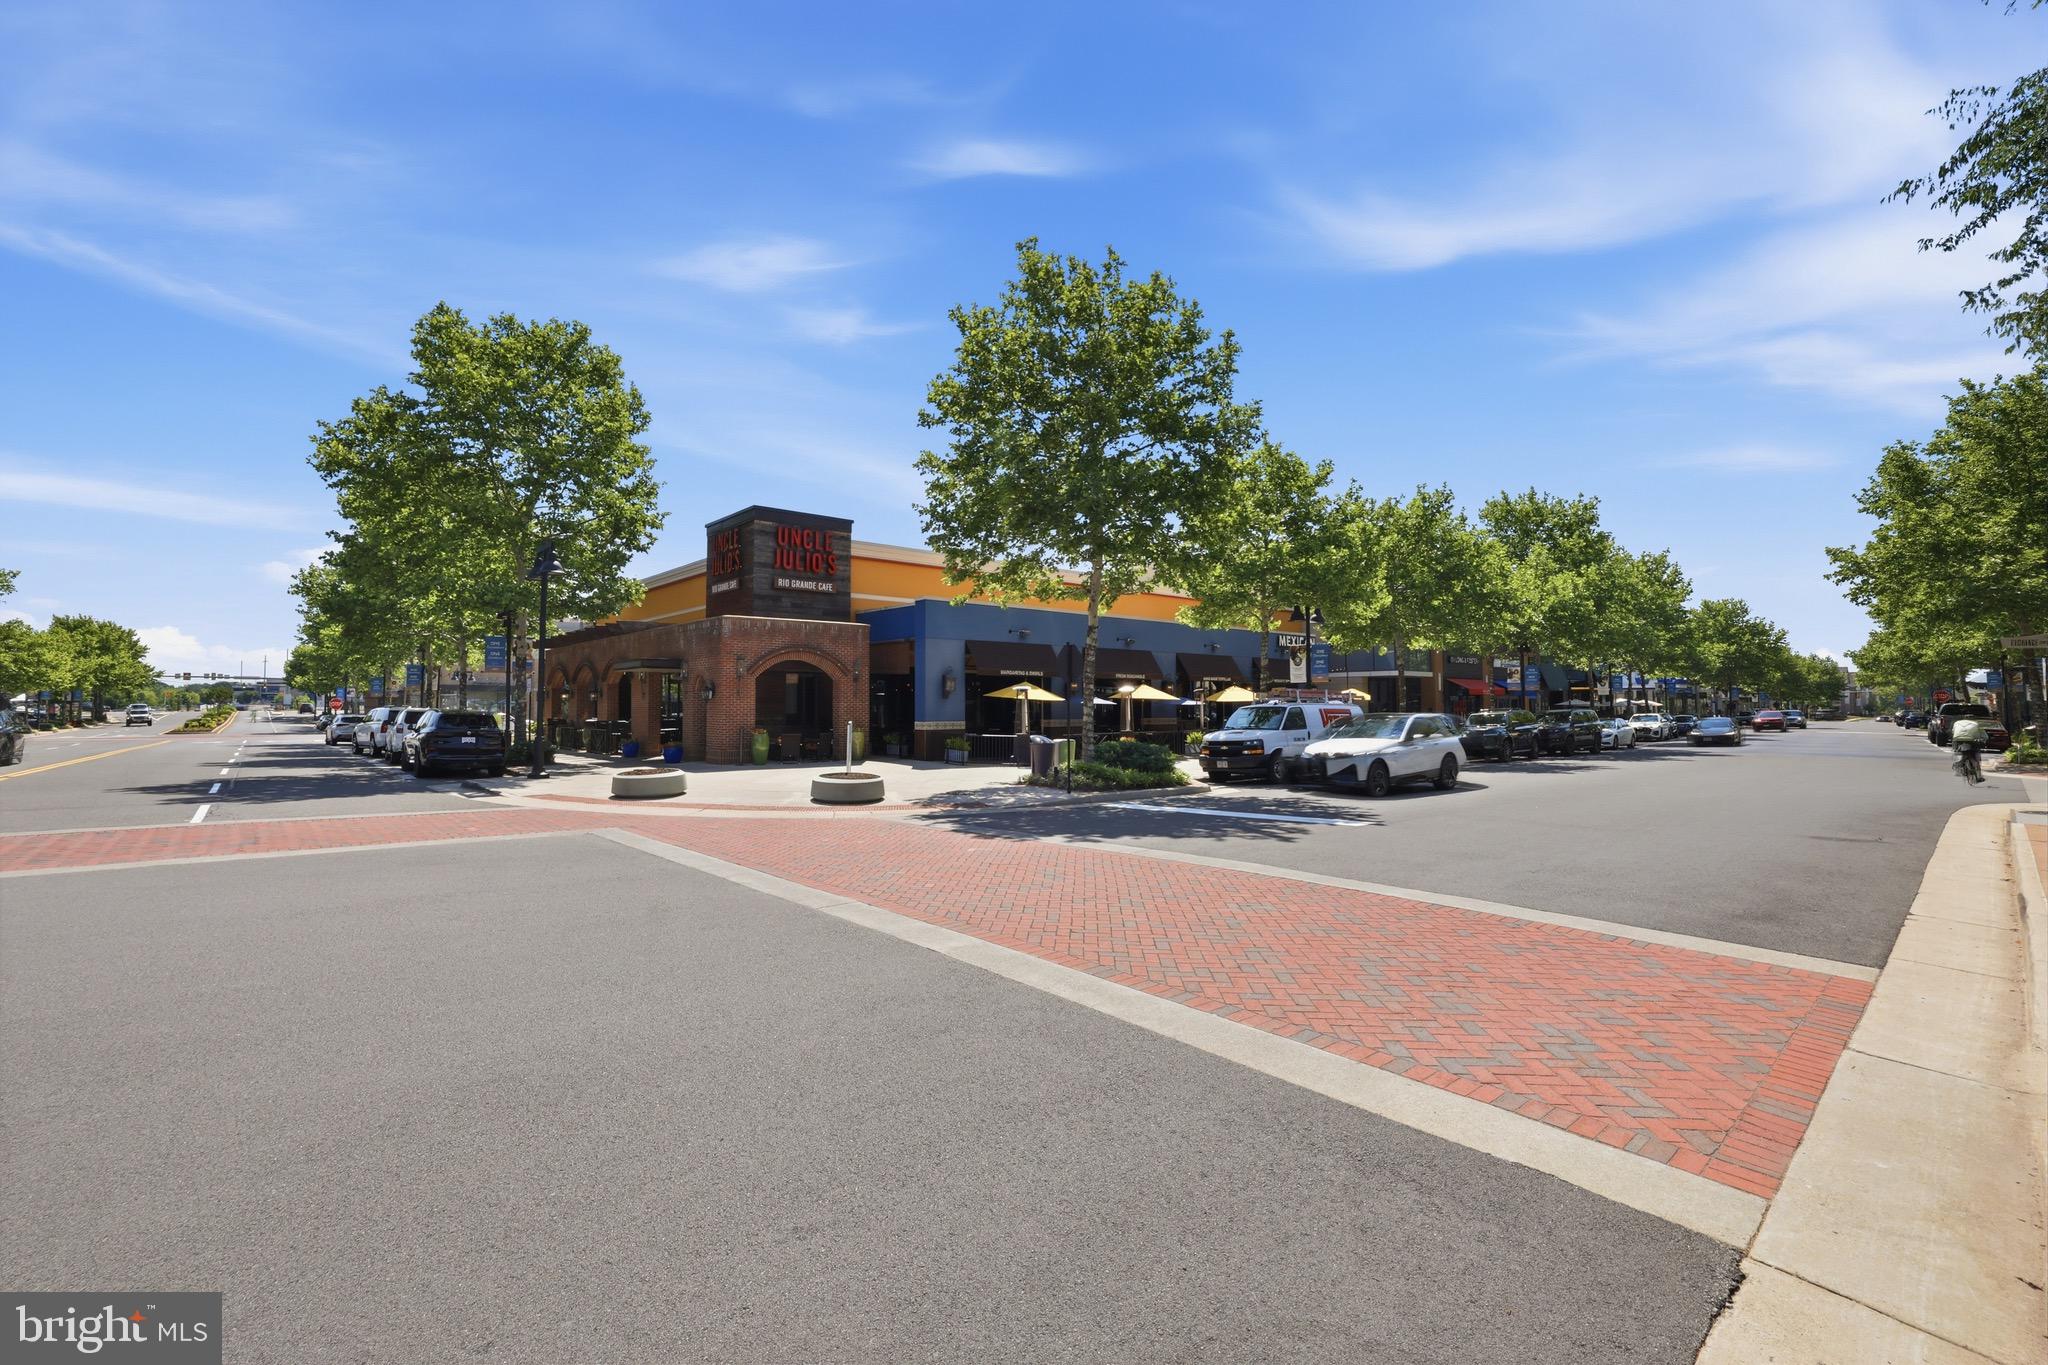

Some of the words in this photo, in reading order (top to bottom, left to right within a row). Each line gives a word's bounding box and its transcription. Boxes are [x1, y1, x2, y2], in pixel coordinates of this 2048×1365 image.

[712, 527, 739, 553] UNCLE
[777, 526, 834, 552] UNCLE
[774, 549, 838, 576] JULIO'S
[777, 578, 790, 588] RIO
[791, 579, 817, 591] GRANDE
[818, 582, 833, 592] CAFE
[1279, 634, 1316, 648] MEXICN
